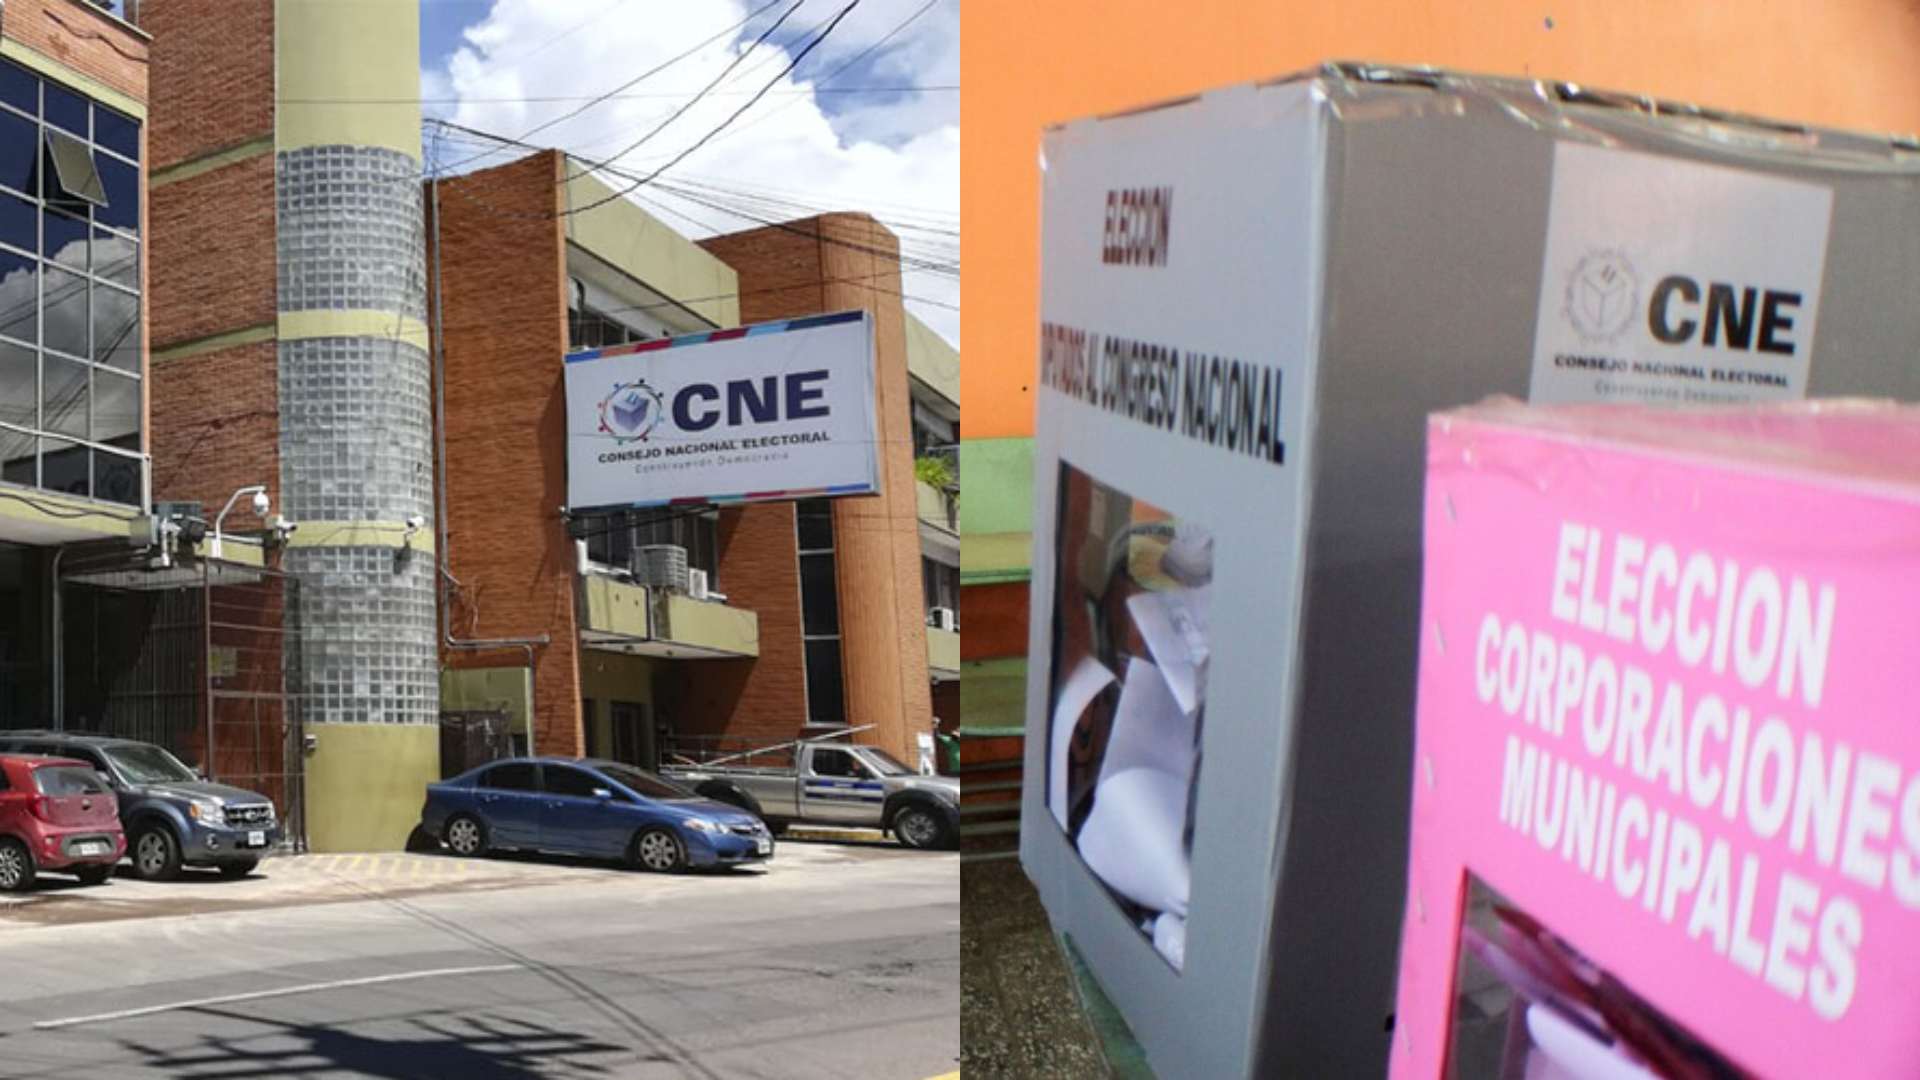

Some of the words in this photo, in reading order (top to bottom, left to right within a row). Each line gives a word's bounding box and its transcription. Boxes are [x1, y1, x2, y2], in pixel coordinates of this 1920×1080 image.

[1103, 186, 1174, 267] ELECCION
[1648, 275, 1803, 356] CNE
[672, 369, 830, 432] CNE
[1101, 334, 1180, 433] CONGRESO
[1181, 351, 1286, 466] NACIONAL
[1554, 354, 1628, 375] CONSEJO
[1632, 362, 1706, 380] NACIONAL
[1710, 370, 1790, 389] ELECTORAL
[598, 447, 662, 464] CONSEJO
[664, 439, 738, 457] NACIONAL
[741, 431, 831, 449] ELECTORAL
[1552, 522, 1837, 710] ELECCION
[1500, 733, 1863, 1021] MUNICIPALES
